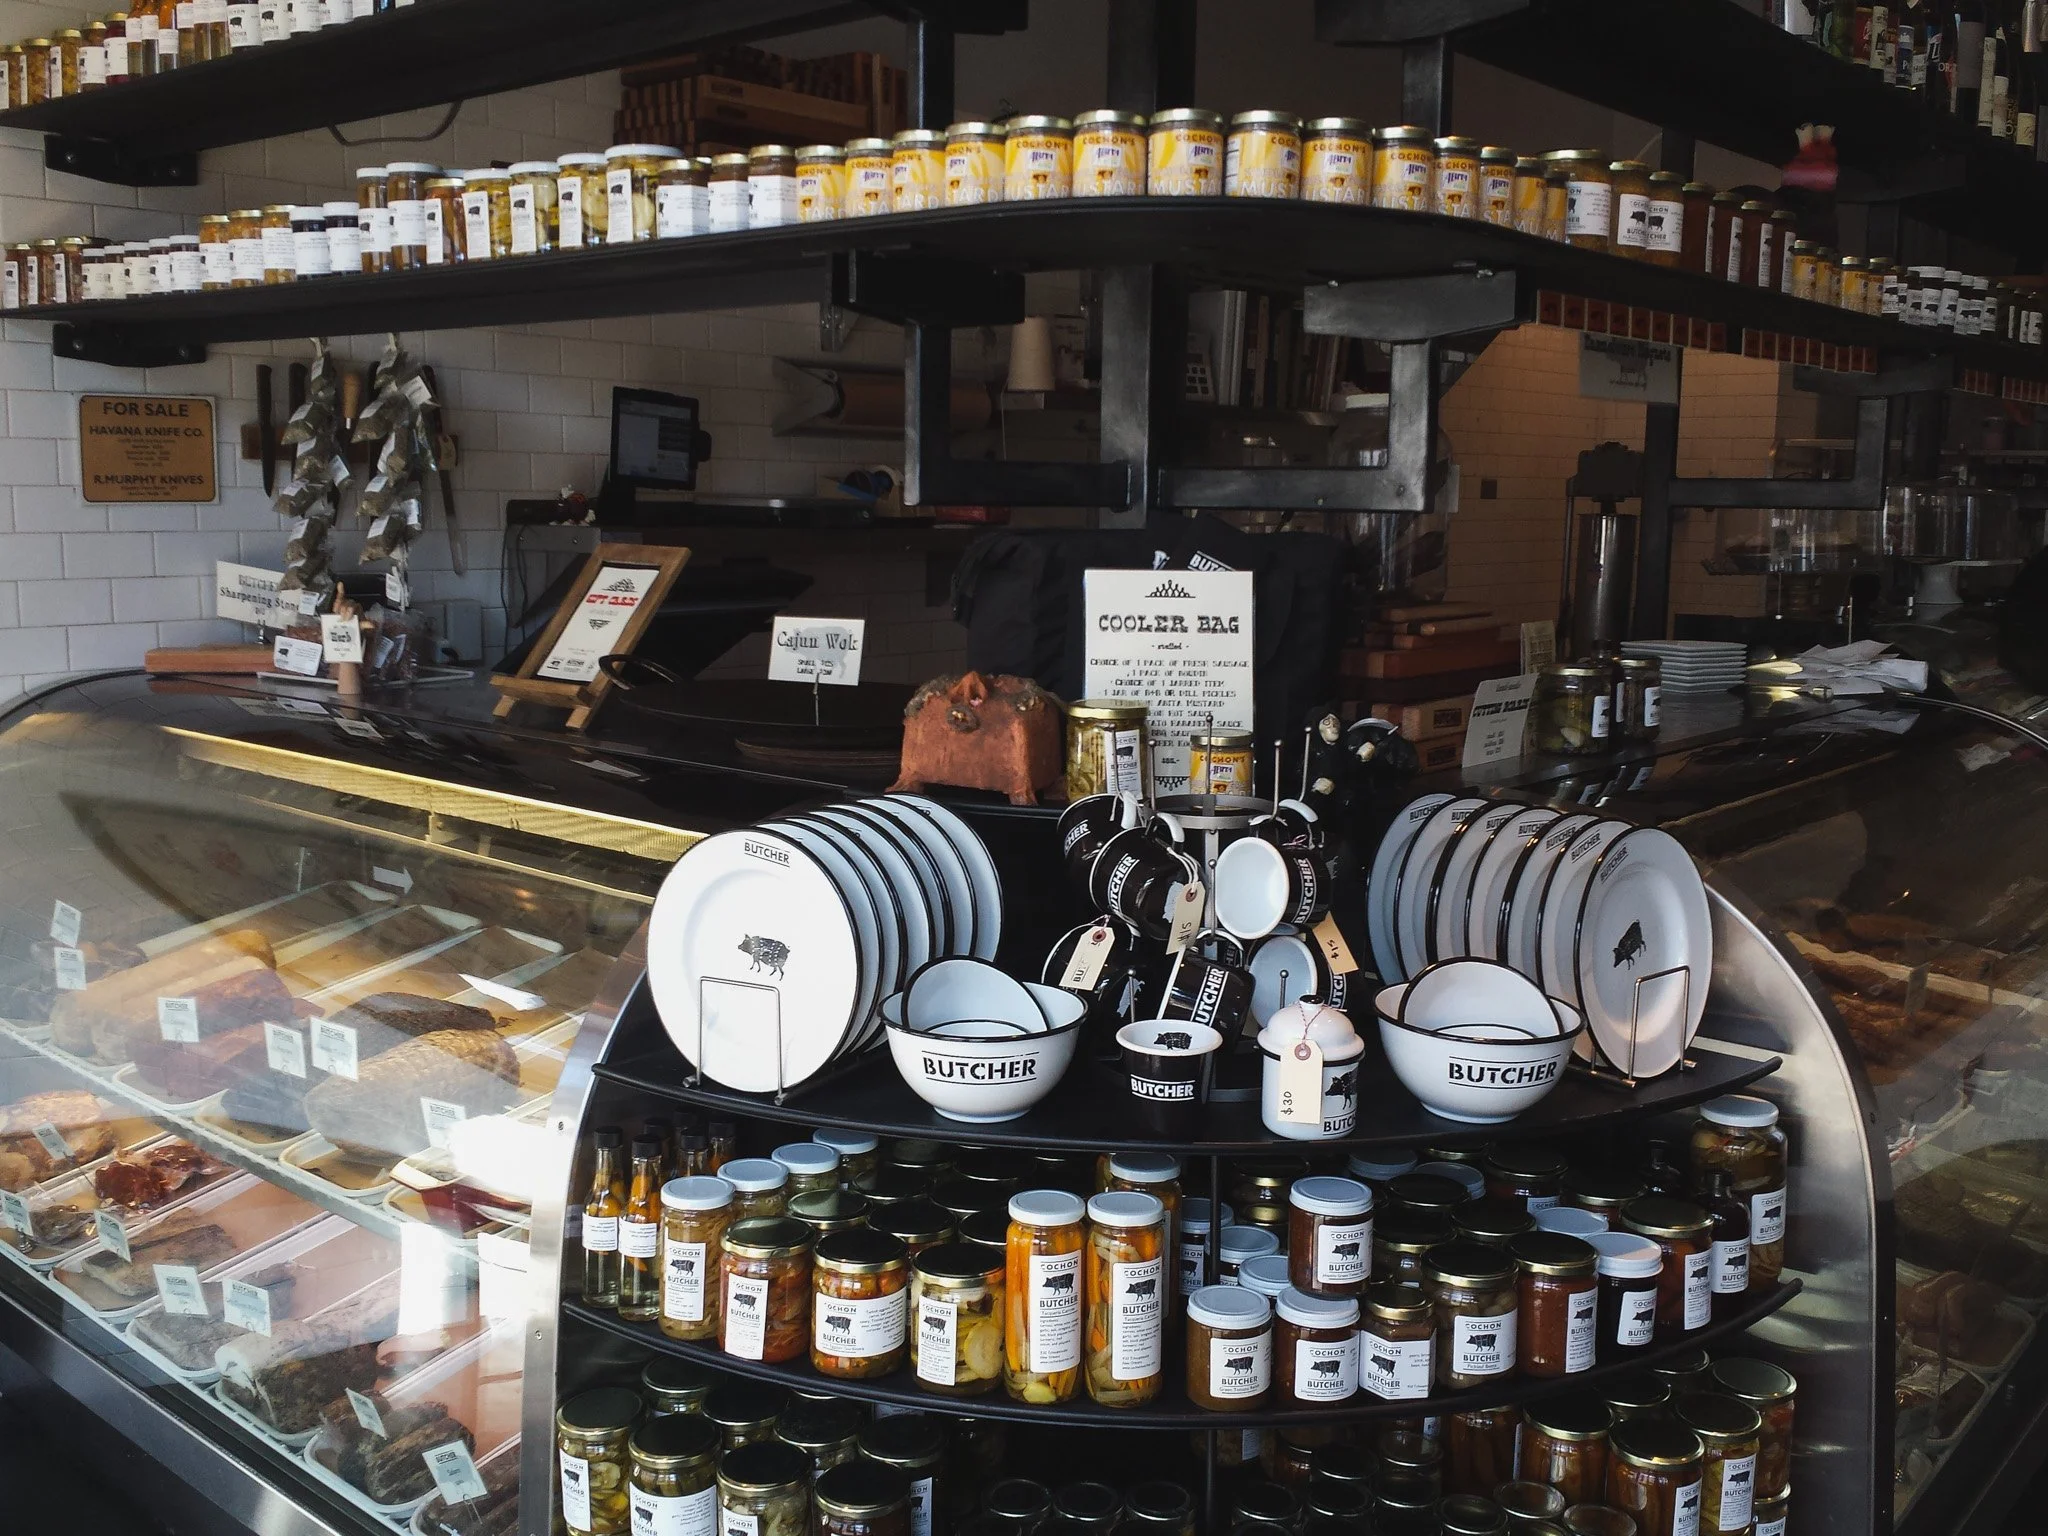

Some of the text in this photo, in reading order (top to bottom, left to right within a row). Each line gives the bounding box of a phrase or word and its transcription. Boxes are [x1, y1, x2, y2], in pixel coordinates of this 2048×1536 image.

[103, 402, 190, 417] FOR SALE
[89, 425, 141, 436] HAVANA
[145, 427, 180, 437] KNIFE
[160, 475, 205, 490] KNIVES
[220, 587, 273, 608] Sharpening
[1099, 614, 1240, 634] COOLER BAG
[777, 631, 859, 651] Cajun Wok
[1110, 761, 1138, 770] BTCHER
[1546, 826, 1576, 850] BUTCHER
[1571, 832, 1601, 861] BUTCHER
[744, 842, 790, 865] BUTCHER
[1600, 846, 1628, 881] BUTCHER
[1294, 858, 1315, 924] BUTCHER
[923, 1057, 1037, 1080] BUTCHER
[1449, 1061, 1558, 1084] BUTCHER
[1131, 1078, 1194, 1098] BUTCHER
[1280, 1091, 1294, 1116] $30
[1331, 1231, 1365, 1240] COCHON
[1041, 1258, 1079, 1271] COCHON
[1124, 1265, 1160, 1277] COCHON
[1328, 1261, 1364, 1271] BUTCHER
[667, 1275, 699, 1285] BUTCHER
[824, 1302, 857, 1313] COCHON
[1039, 1295, 1079, 1308] BUTCHER
[1122, 1301, 1159, 1314] BUTCHER
[730, 1308, 761, 1320] BUTCHER
[1465, 1322, 1501, 1330] COCHON
[823, 1333, 857, 1345] BUTCHER
[921, 1332, 951, 1344] BUTCHER
[1223, 1344, 1258, 1353] COCHON
[1310, 1348, 1346, 1356] COCHON
[1369, 1340, 1401, 1355] COCHON
[1463, 1354, 1500, 1362] BUTCHER
[1221, 1376, 1258, 1385] BUTCHER
[1307, 1379, 1344, 1388] BUTCHER
[1367, 1372, 1400, 1387] BUTCHER
